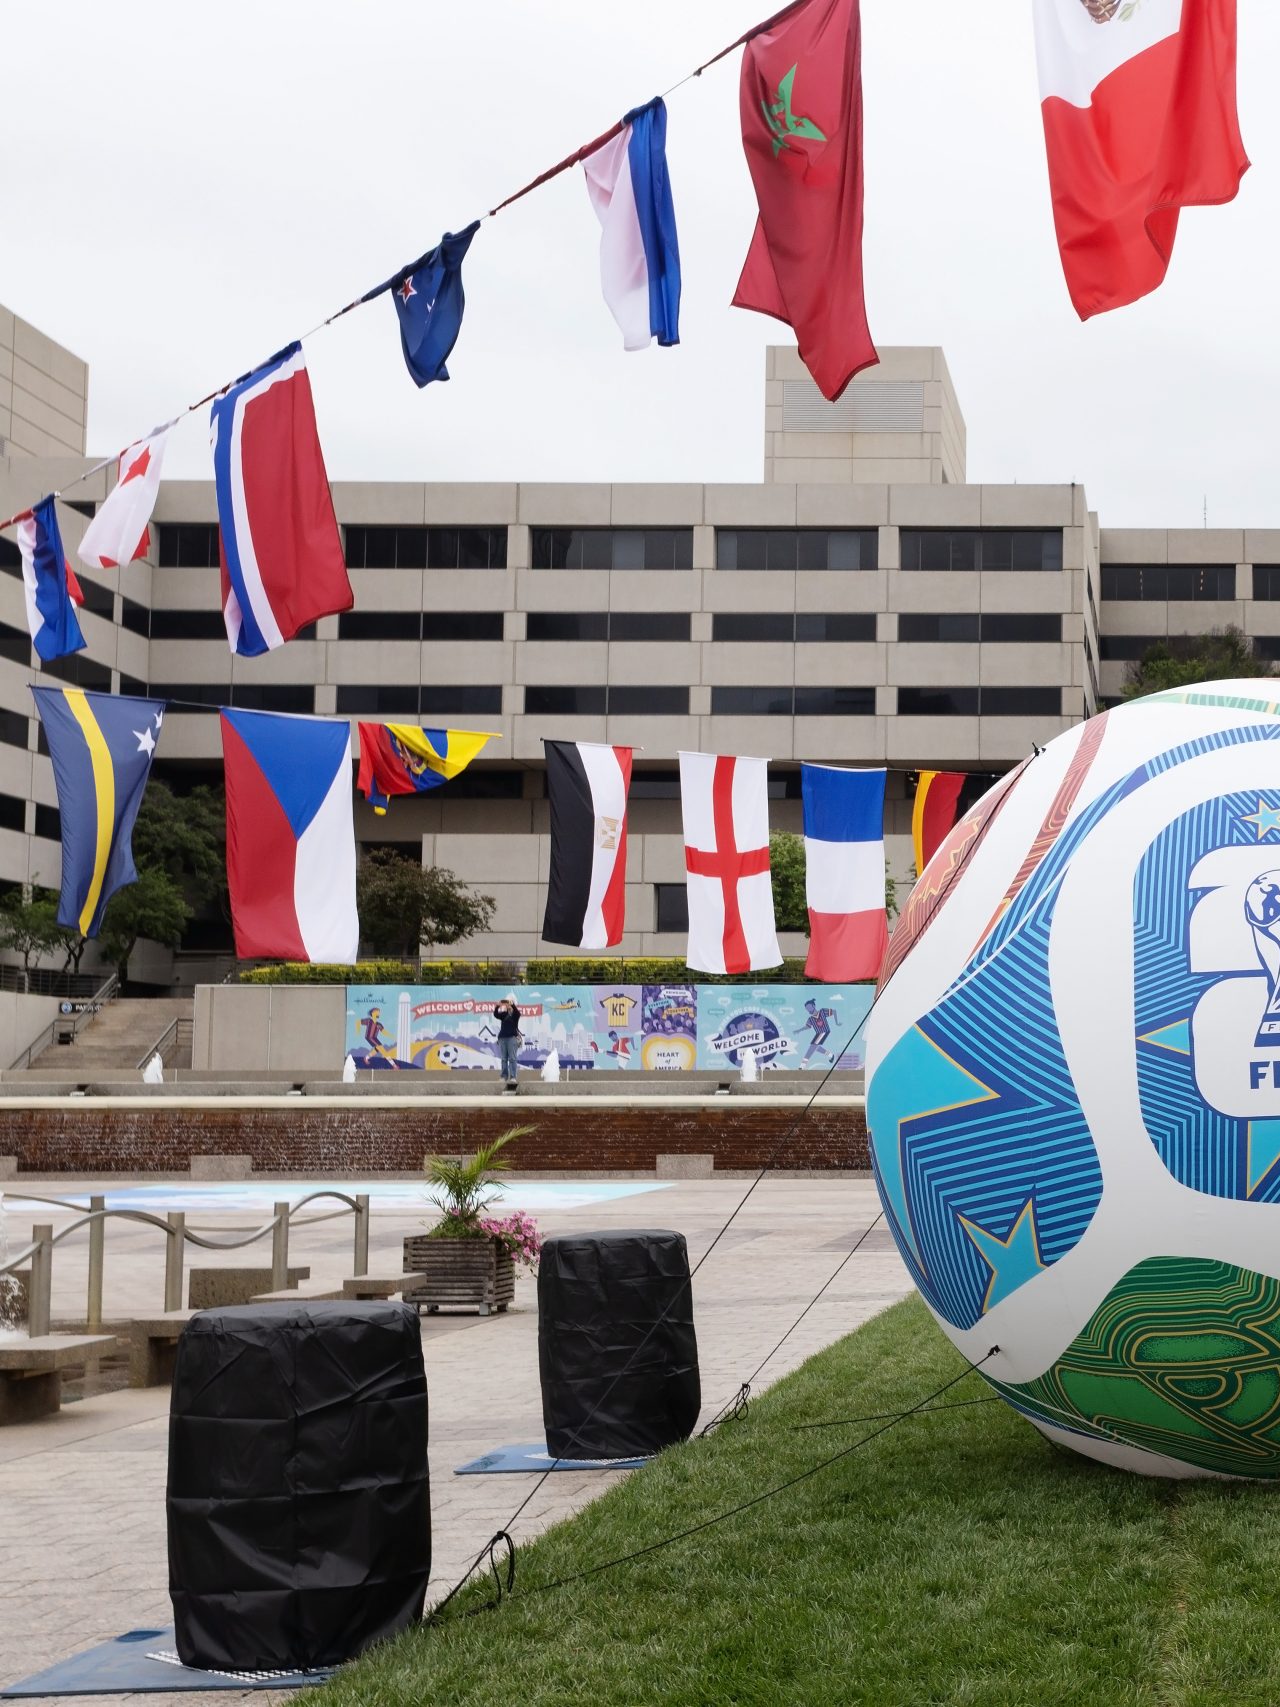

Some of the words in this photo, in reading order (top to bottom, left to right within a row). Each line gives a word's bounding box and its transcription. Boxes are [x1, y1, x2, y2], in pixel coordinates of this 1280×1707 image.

[417, 1003, 463, 1014] WELCOME
[612, 1003, 625, 1016] KC
[714, 1033, 760, 1050] WELCOME
[752, 1040, 787, 1055] WORLD
